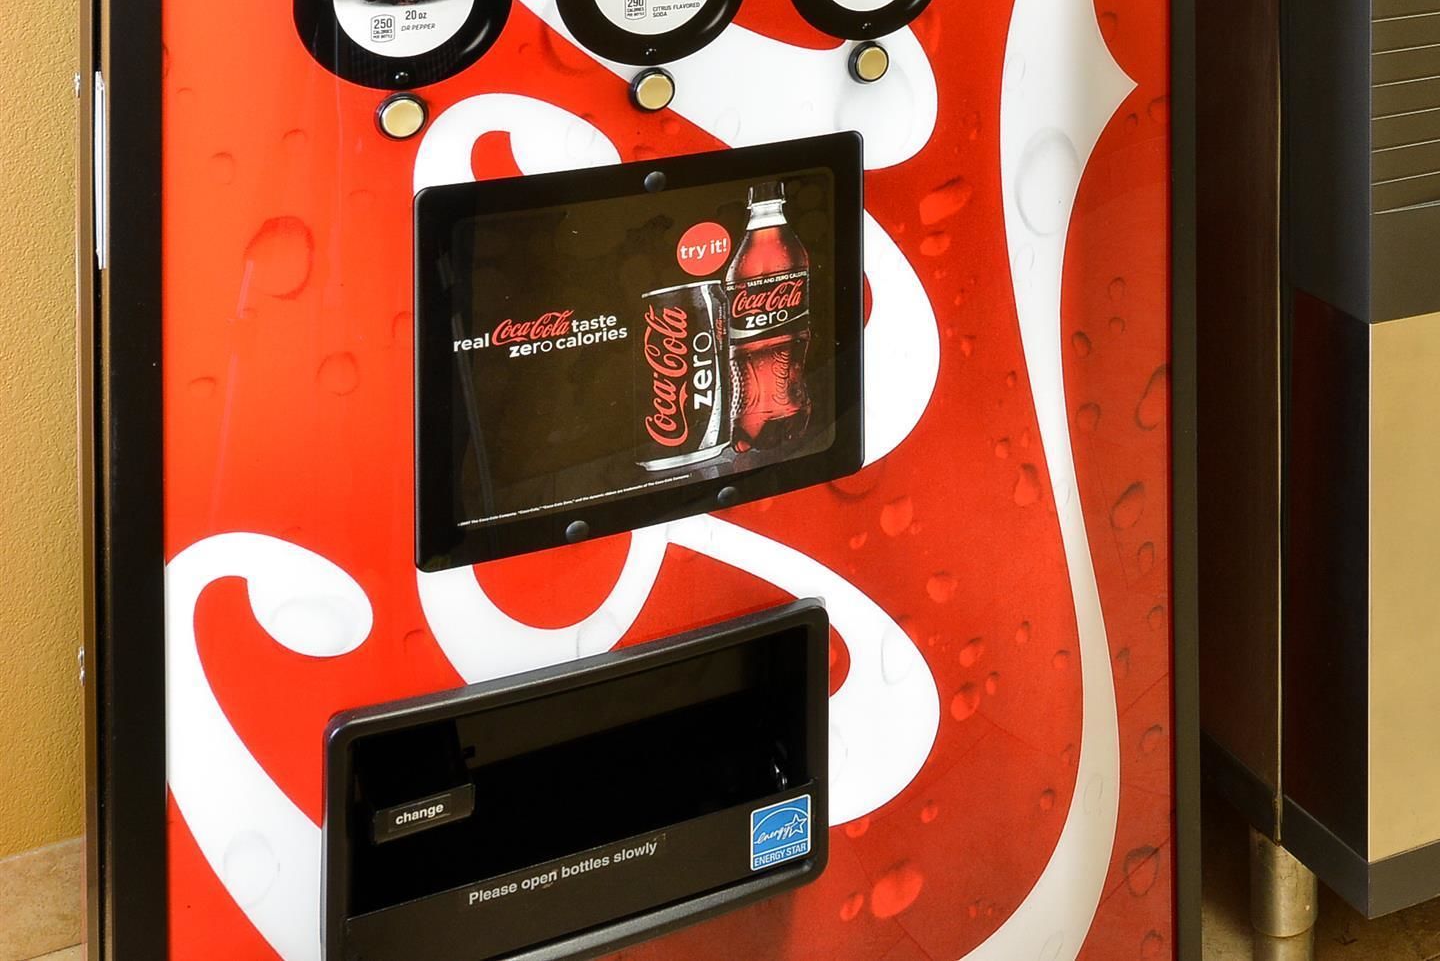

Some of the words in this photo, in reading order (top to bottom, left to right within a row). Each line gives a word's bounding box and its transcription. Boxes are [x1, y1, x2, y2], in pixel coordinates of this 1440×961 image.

[405, 10, 416, 20] 20
[673, 2, 700, 10] FLAVORED
[374, 18, 392, 29] 250
[680, 244, 706, 260] try
[710, 238, 728, 254] it!
[732, 279, 803, 318] Coca-Cola
[453, 332, 490, 352] real
[491, 309, 575, 346] Coca-Cola
[571, 313, 617, 333] taste
[745, 309, 788, 328] zero
[509, 340, 553, 358] zero
[556, 327, 628, 350] calories
[644, 303, 688, 447] Coca-Cola
[693, 332, 713, 410] zero
[395, 804, 444, 825] change
[754, 849, 785, 867] ENERGY
[786, 843, 807, 856] STAR
[468, 884, 517, 905] Please
[521, 871, 558, 890] open
[561, 855, 610, 879] bottles
[613, 842, 657, 863] slowly
